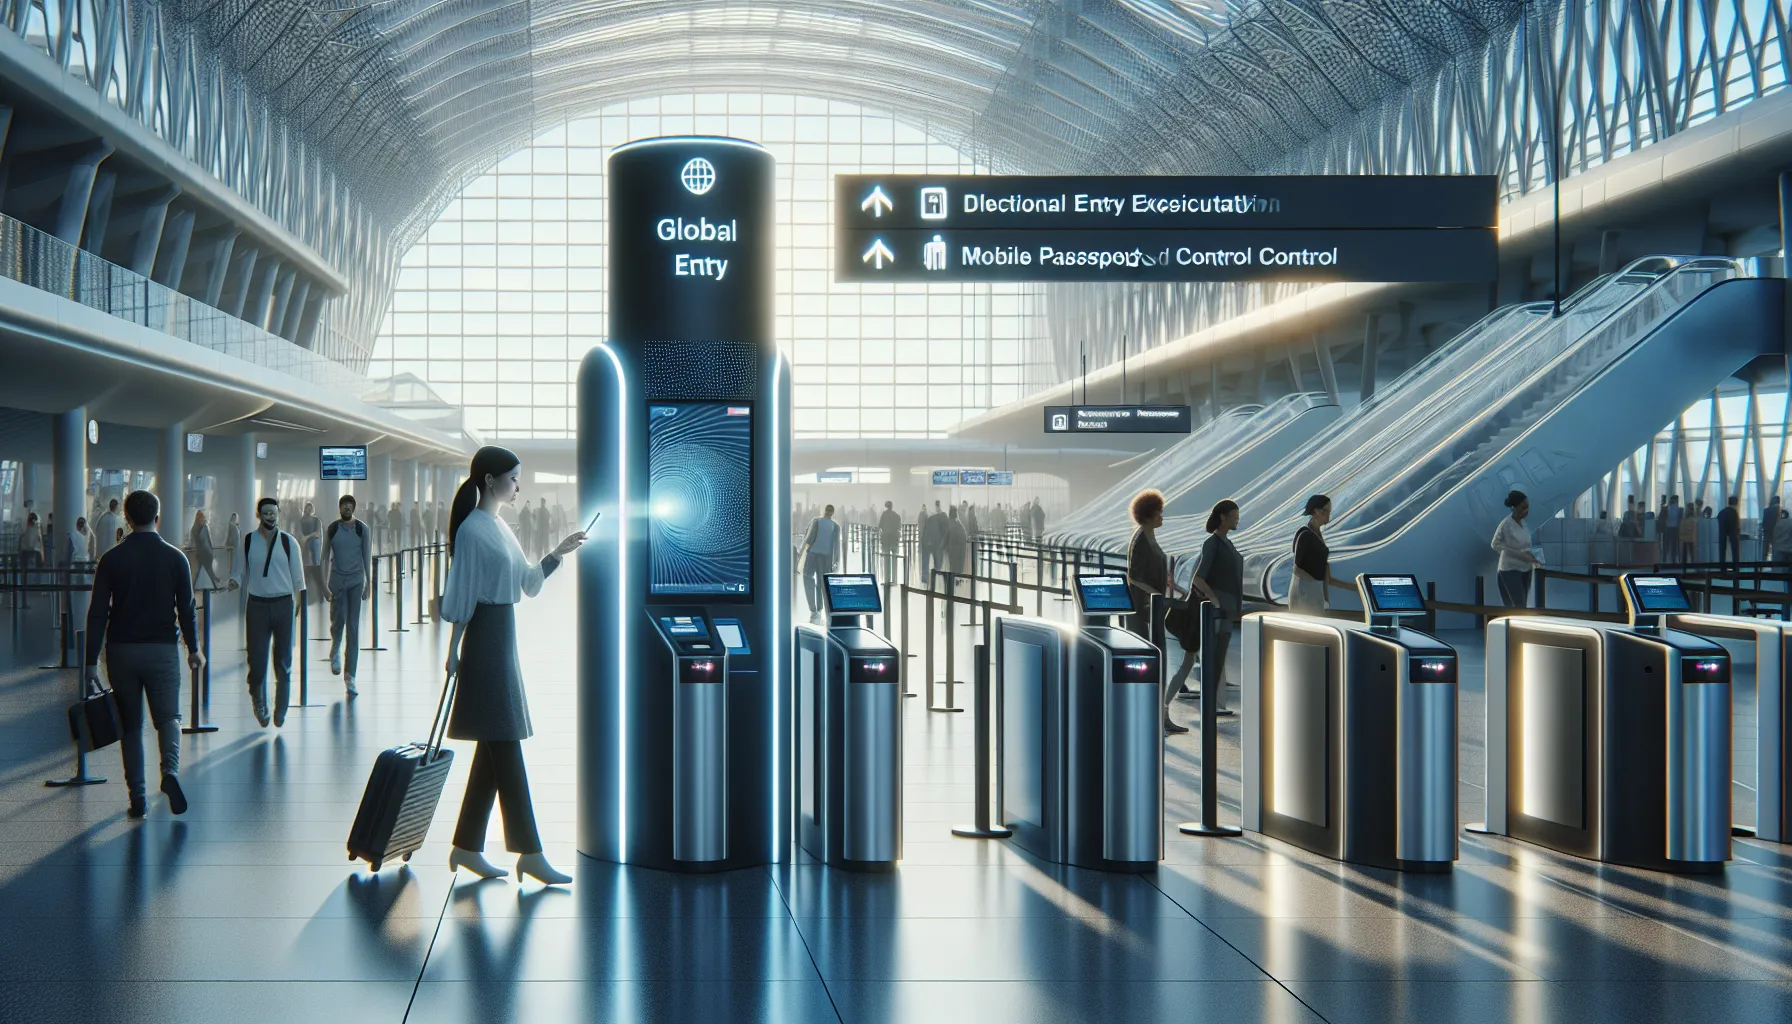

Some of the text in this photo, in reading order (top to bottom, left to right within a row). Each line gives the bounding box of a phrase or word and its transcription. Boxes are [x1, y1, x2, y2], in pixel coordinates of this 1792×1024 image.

[1074, 193, 1126, 217] Entry
[656, 216, 737, 242] Global
[675, 253, 729, 281] Entry
[961, 246, 1032, 265] Mobile
[1175, 247, 1252, 266] Control
[1258, 247, 1338, 266] Control
